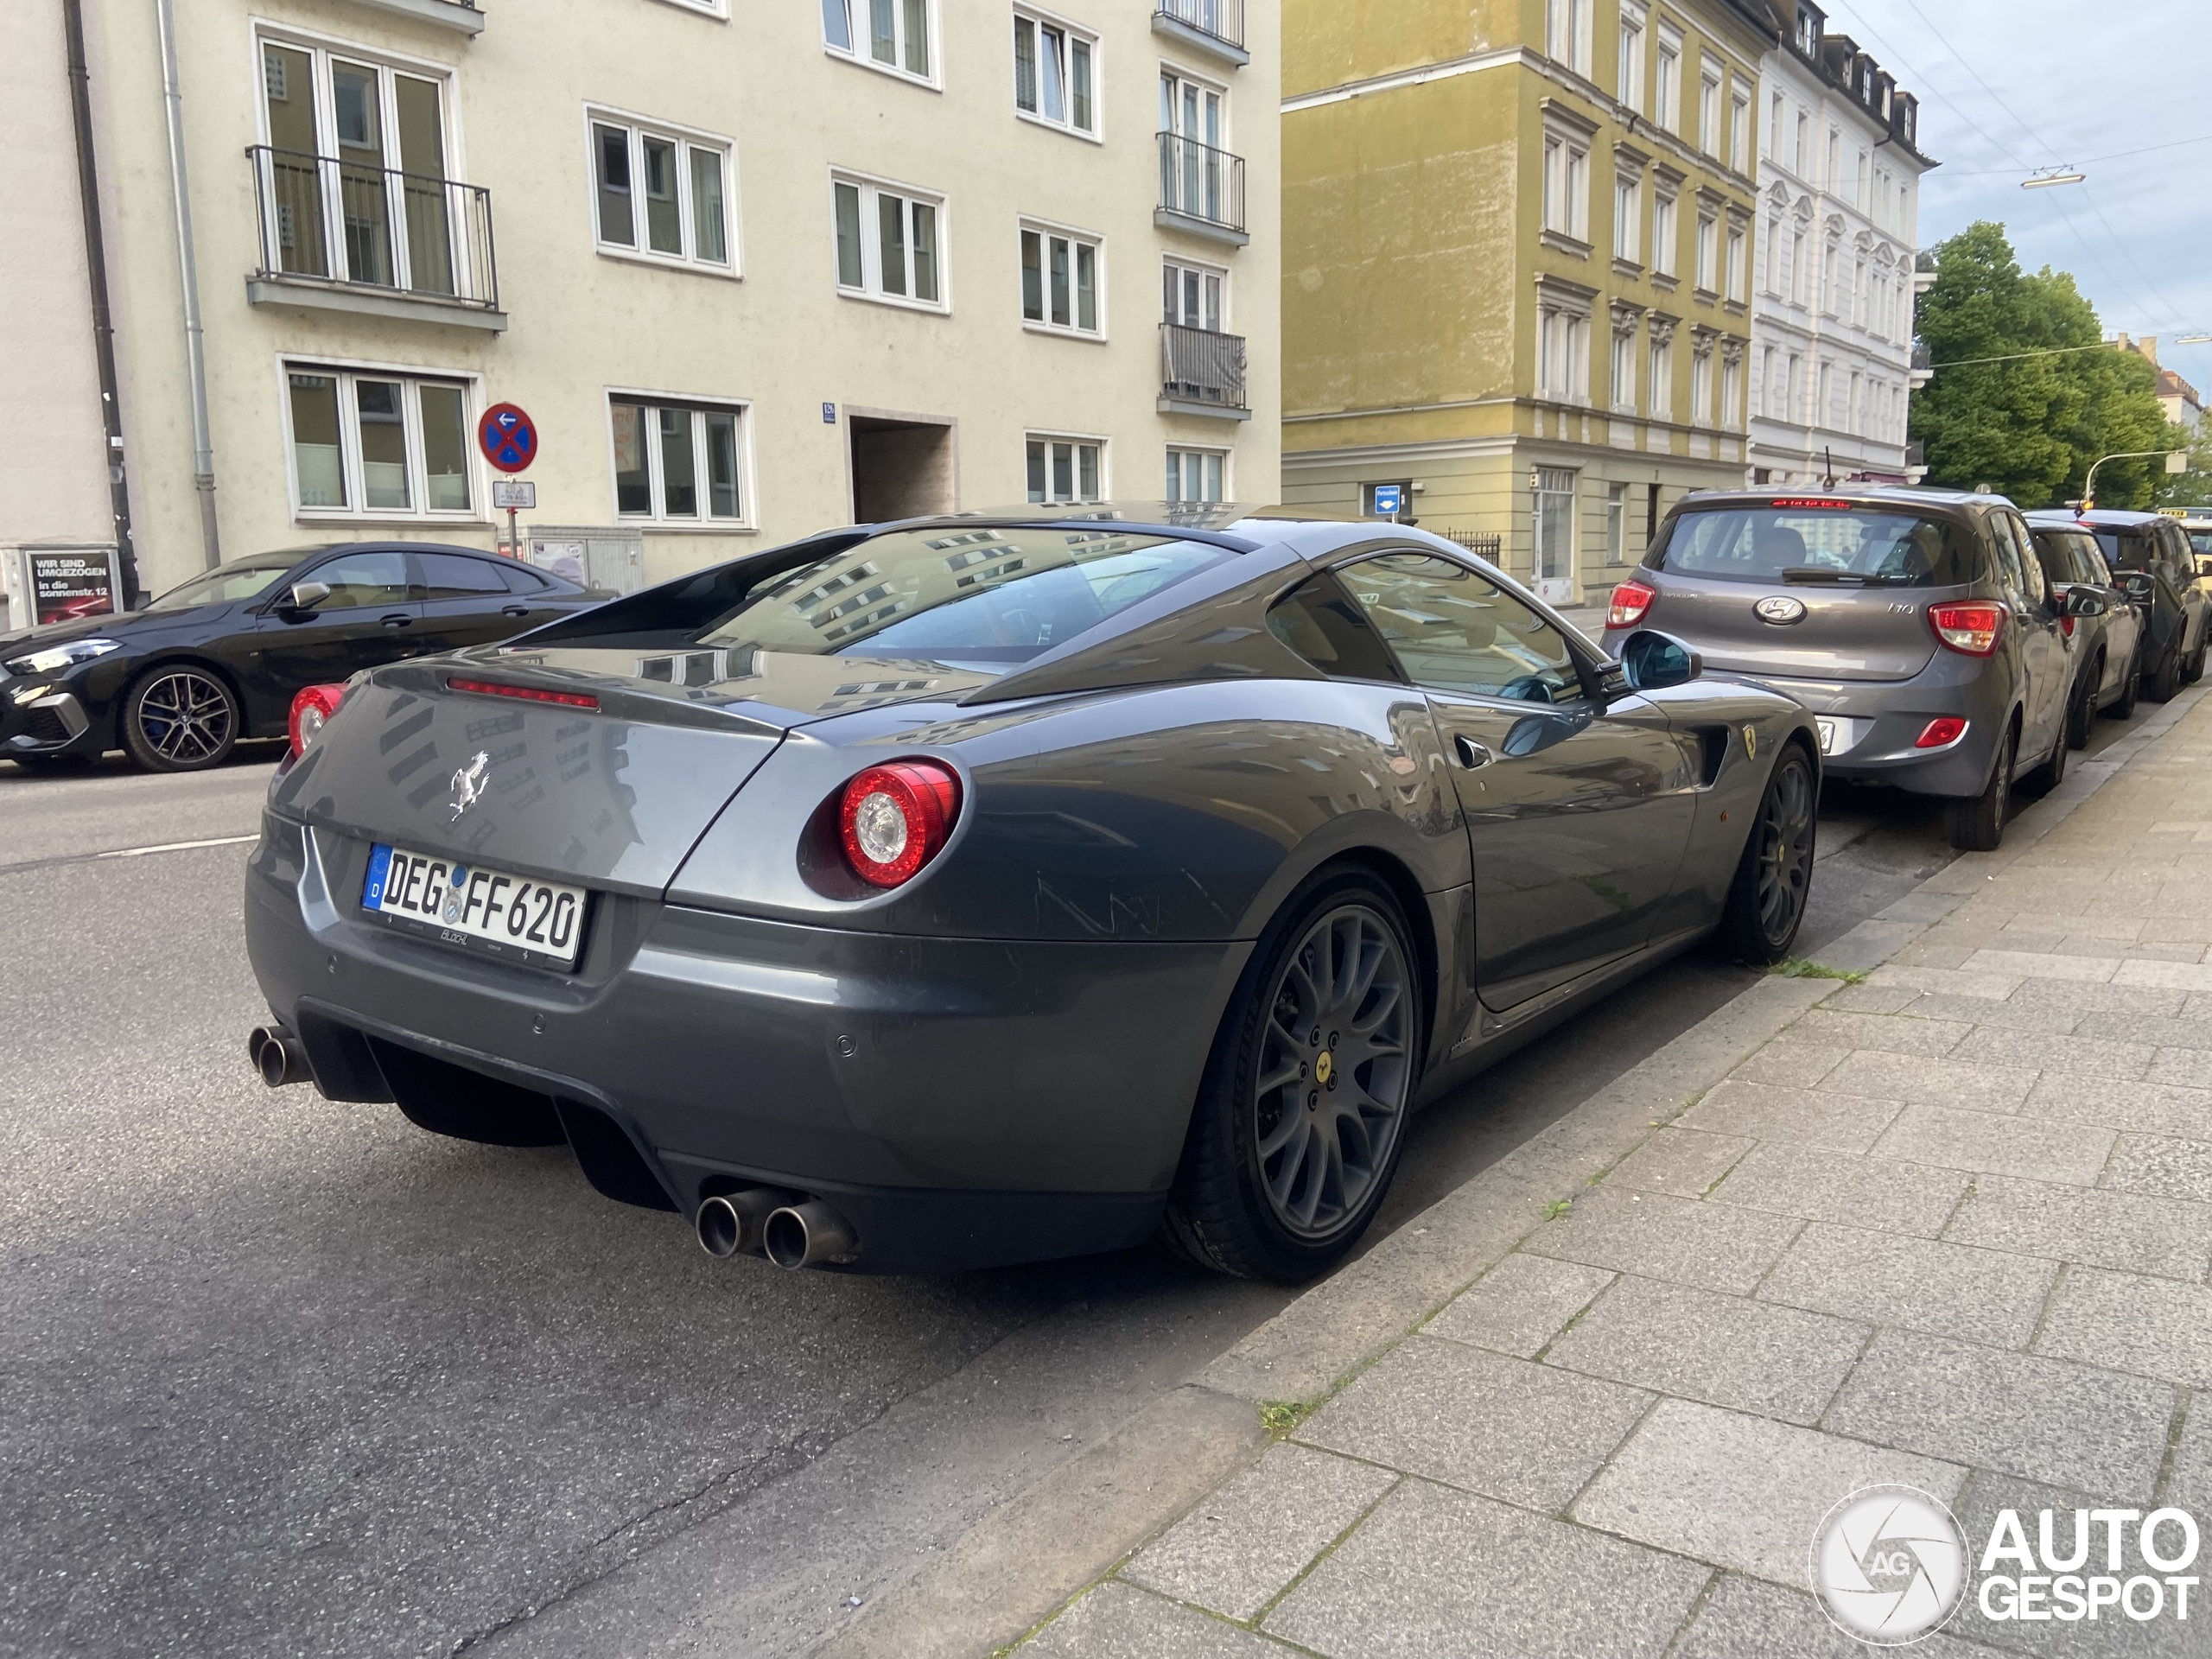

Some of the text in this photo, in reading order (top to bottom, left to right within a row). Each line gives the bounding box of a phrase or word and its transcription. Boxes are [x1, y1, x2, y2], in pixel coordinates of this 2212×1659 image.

[35, 559, 86, 569] WIR SIND
[37, 567, 106, 577] UMGEZOGEN
[38, 581, 68, 590] in die
[39, 587, 108, 598] sonnenstr. 12
[384, 854, 448, 916] DEG
[371, 884, 379, 899] D
